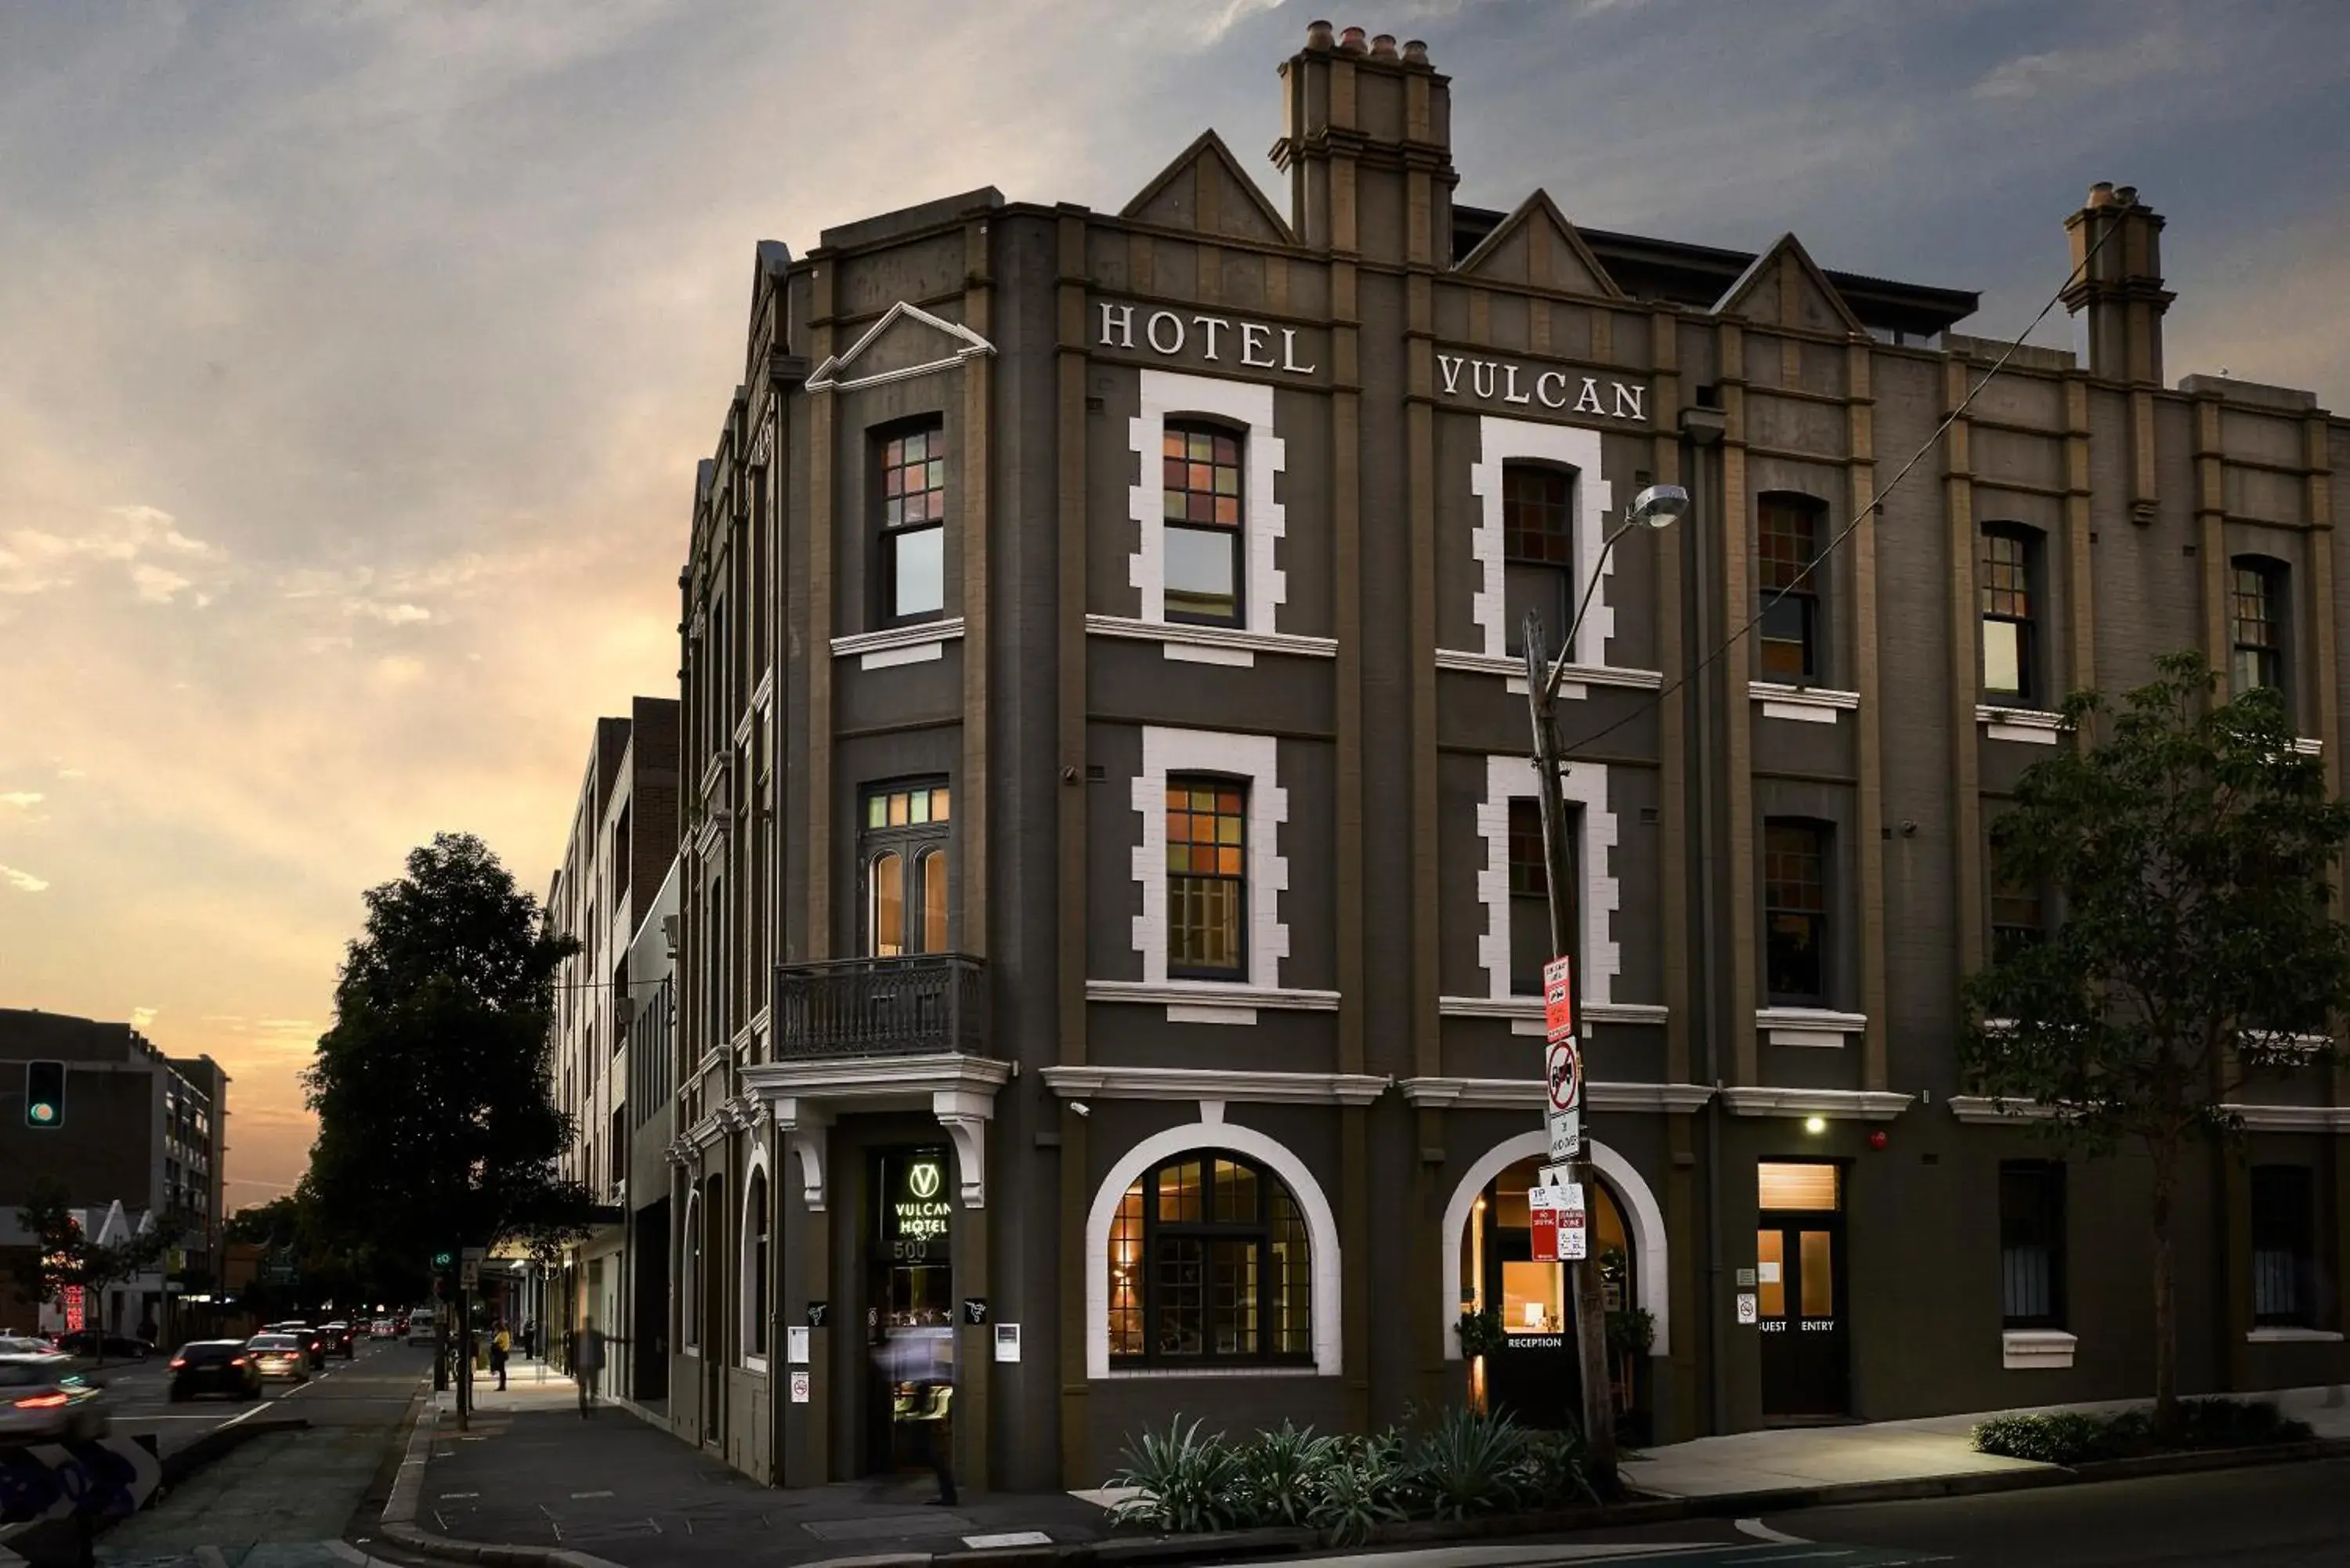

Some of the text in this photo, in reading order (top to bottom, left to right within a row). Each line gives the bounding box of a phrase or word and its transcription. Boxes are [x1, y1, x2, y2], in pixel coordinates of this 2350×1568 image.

[1099, 302, 1647, 421] HOTEL VULCAN
[913, 1164, 937, 1195] V
[899, 1219, 948, 1234] HOTEL
[894, 1241, 927, 1259] 500
[1801, 1321, 1834, 1331] ENTRY
[1507, 1336, 1562, 1349] RECEPTION
